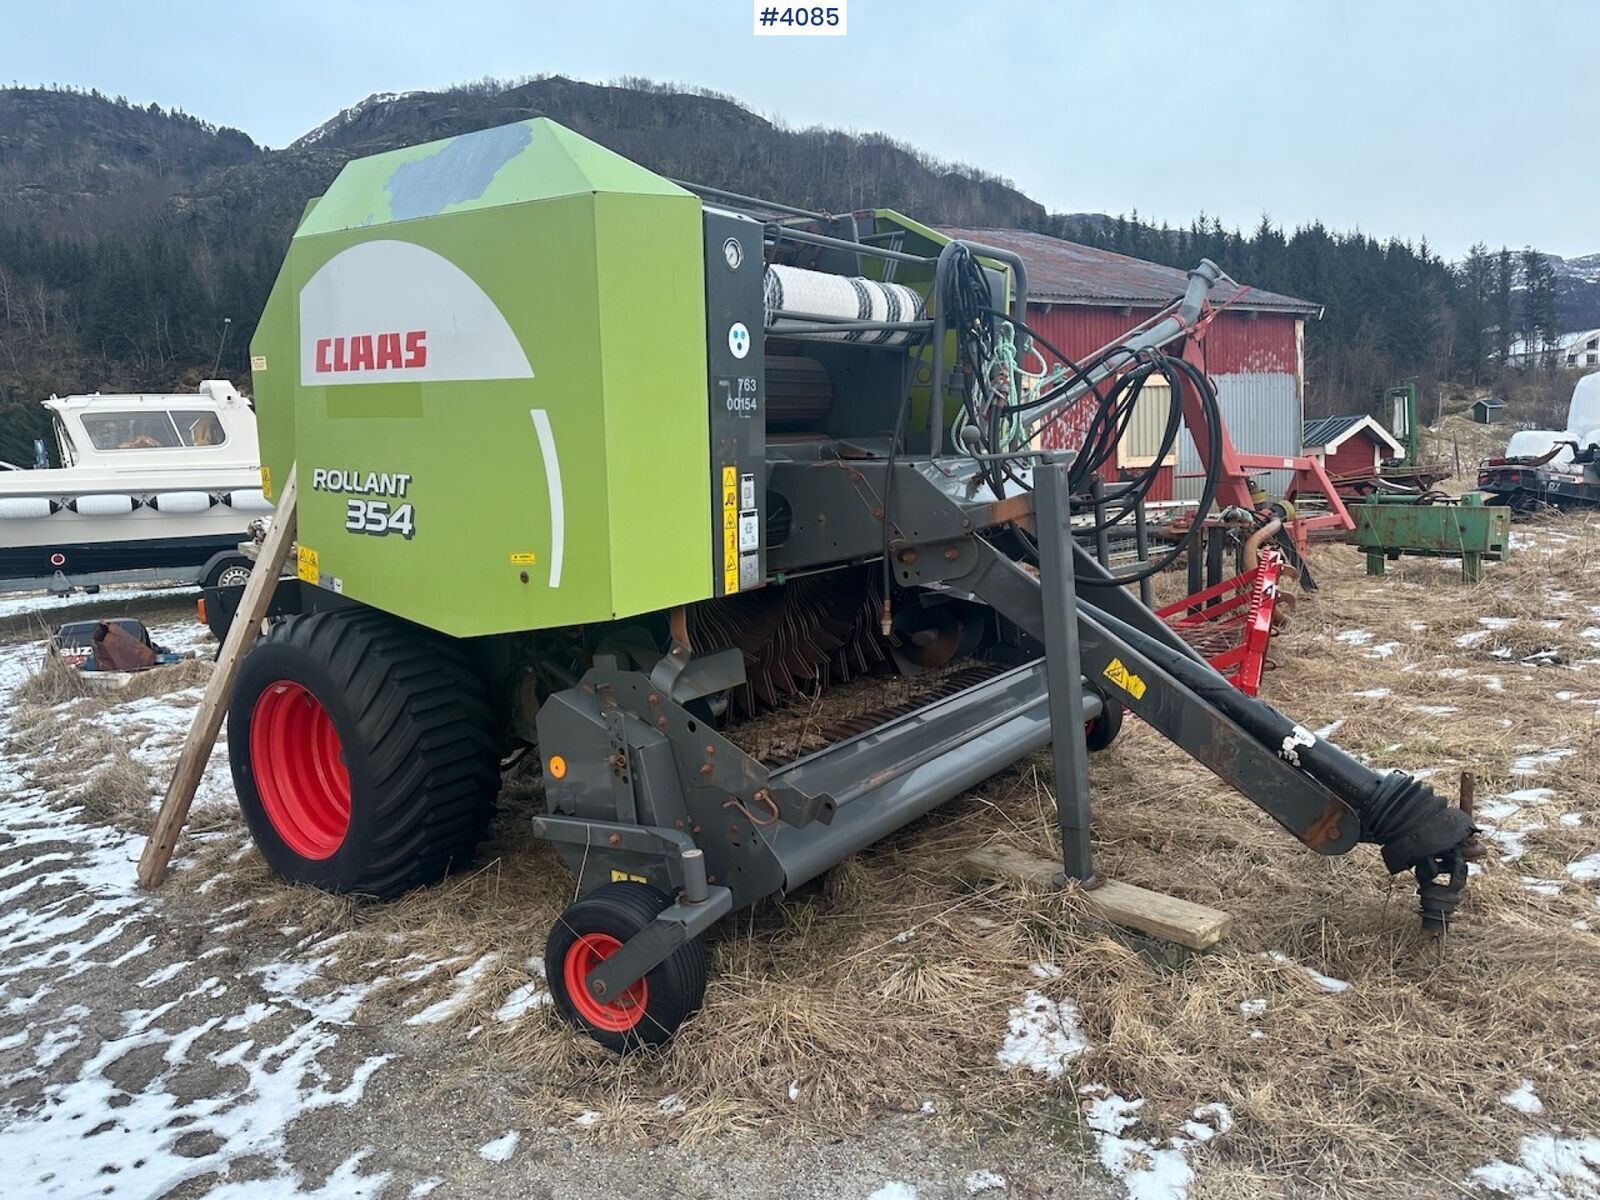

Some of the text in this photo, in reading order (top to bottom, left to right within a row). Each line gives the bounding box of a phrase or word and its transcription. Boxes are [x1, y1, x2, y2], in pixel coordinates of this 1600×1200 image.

[316, 331, 426, 372] CLAAS
[738, 378, 757, 392] 763
[727, 397, 757, 411] 00154
[313, 468, 411, 498] ROLLANT
[345, 499, 415, 540] 354
[60, 646, 94, 657] SUZ
